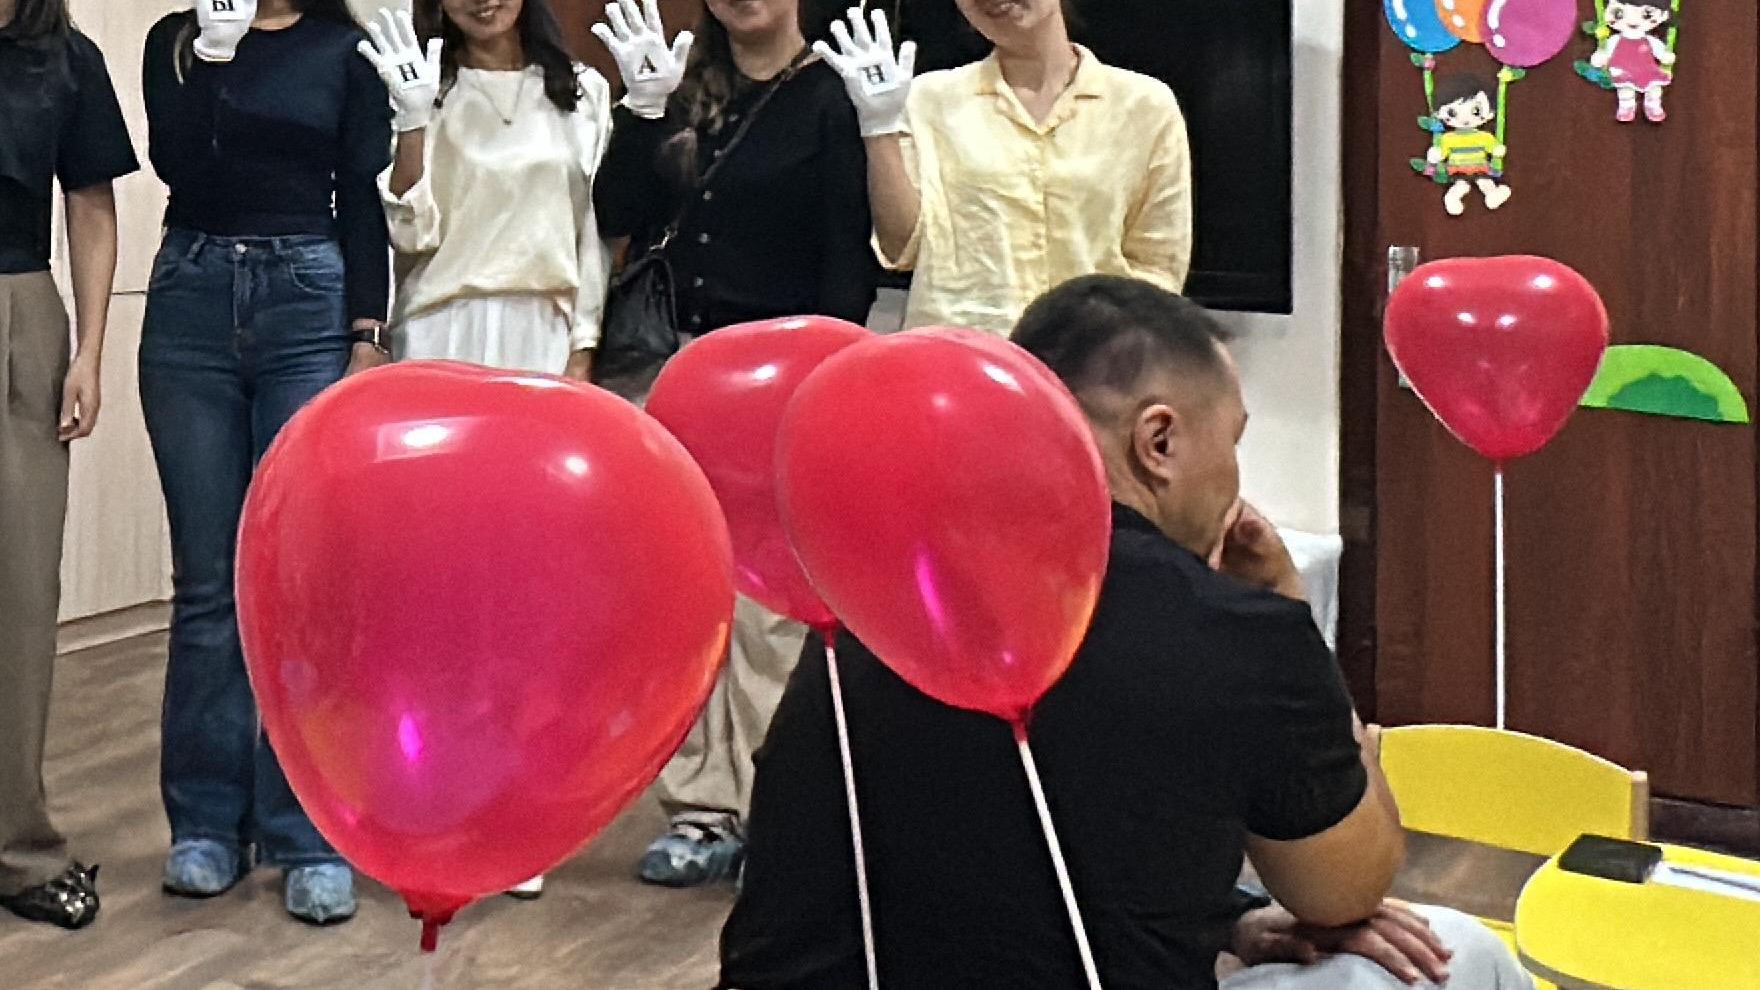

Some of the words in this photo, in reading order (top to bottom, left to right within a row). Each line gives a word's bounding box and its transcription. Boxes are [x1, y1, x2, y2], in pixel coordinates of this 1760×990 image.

[396, 61, 420, 83] Н
[638, 53, 657, 74] А
[860, 64, 886, 85] Н
